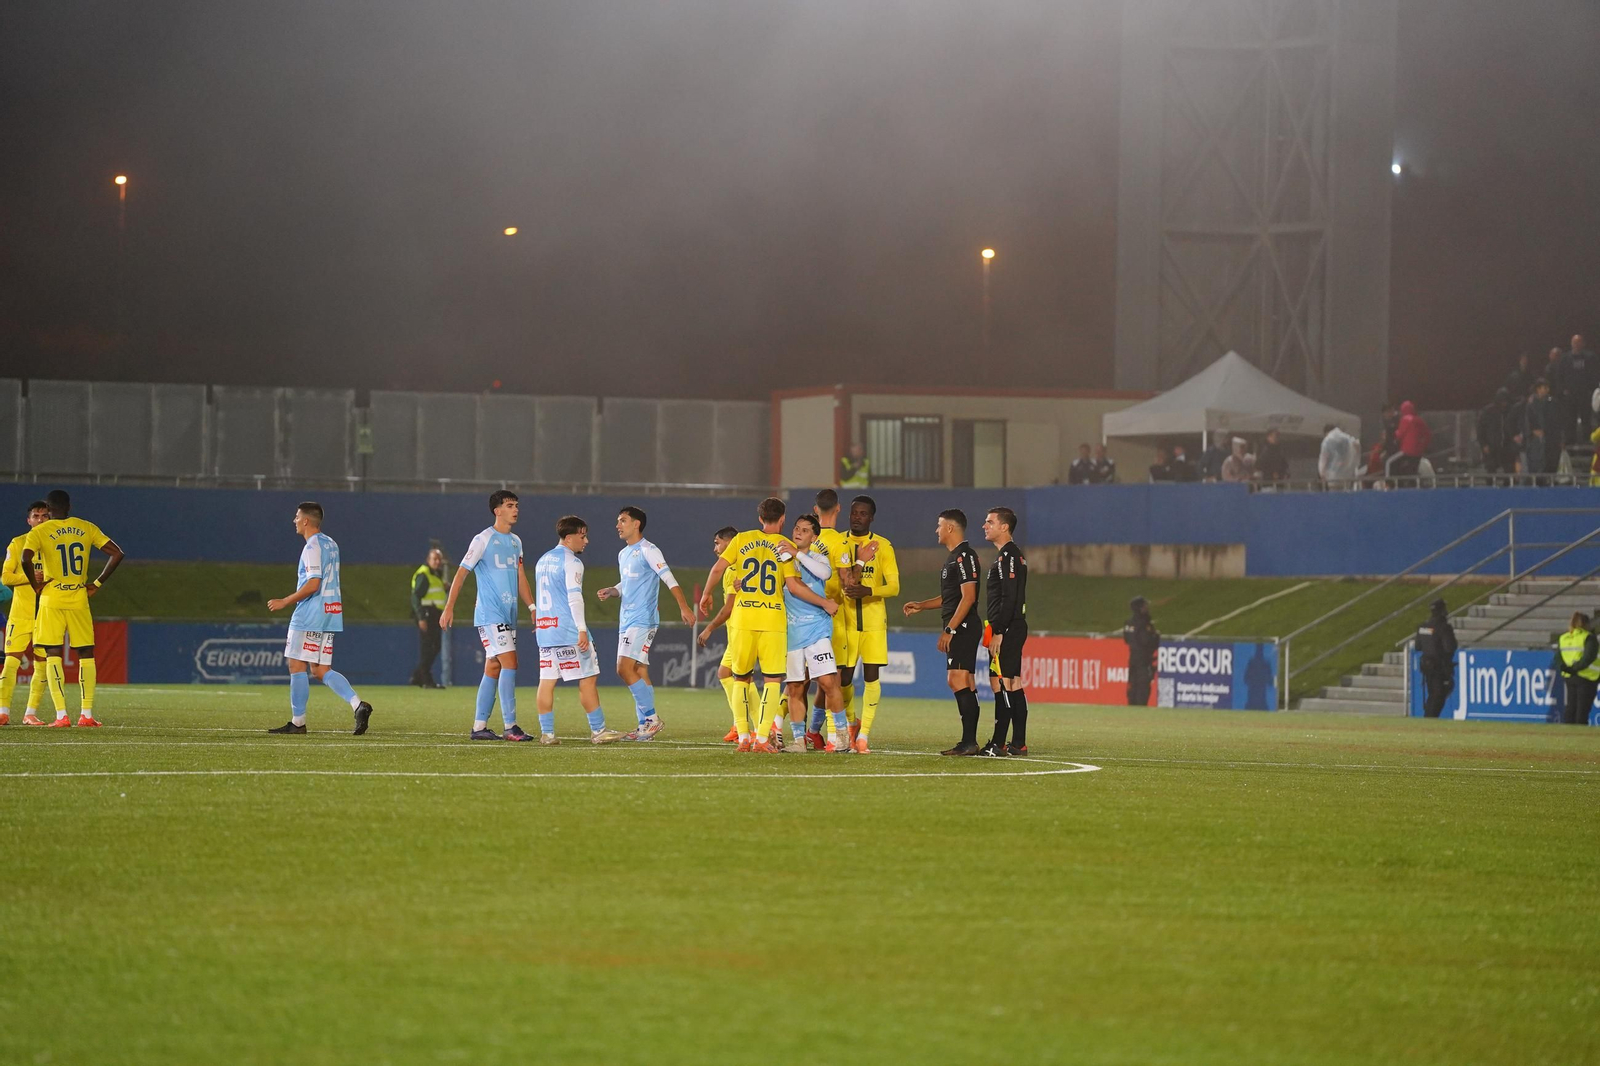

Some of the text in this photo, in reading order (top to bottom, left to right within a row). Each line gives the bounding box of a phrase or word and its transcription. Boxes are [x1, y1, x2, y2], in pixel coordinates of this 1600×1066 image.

[56, 526, 86, 538] PARTEY
[739, 541, 755, 556] PAU
[812, 539, 830, 556] ARÍN
[56, 542, 85, 577] 16
[741, 557, 777, 596] 26
[539, 575, 552, 611] 6
[737, 600, 782, 610] ASCALE
[206, 650, 289, 667] EUROMA
[816, 652, 834, 662] GTL
[1157, 646, 1232, 675] RECOSUR
[1032, 657, 1101, 690] COPA DEL REY
[1453, 650, 1557, 721] Jiménez
